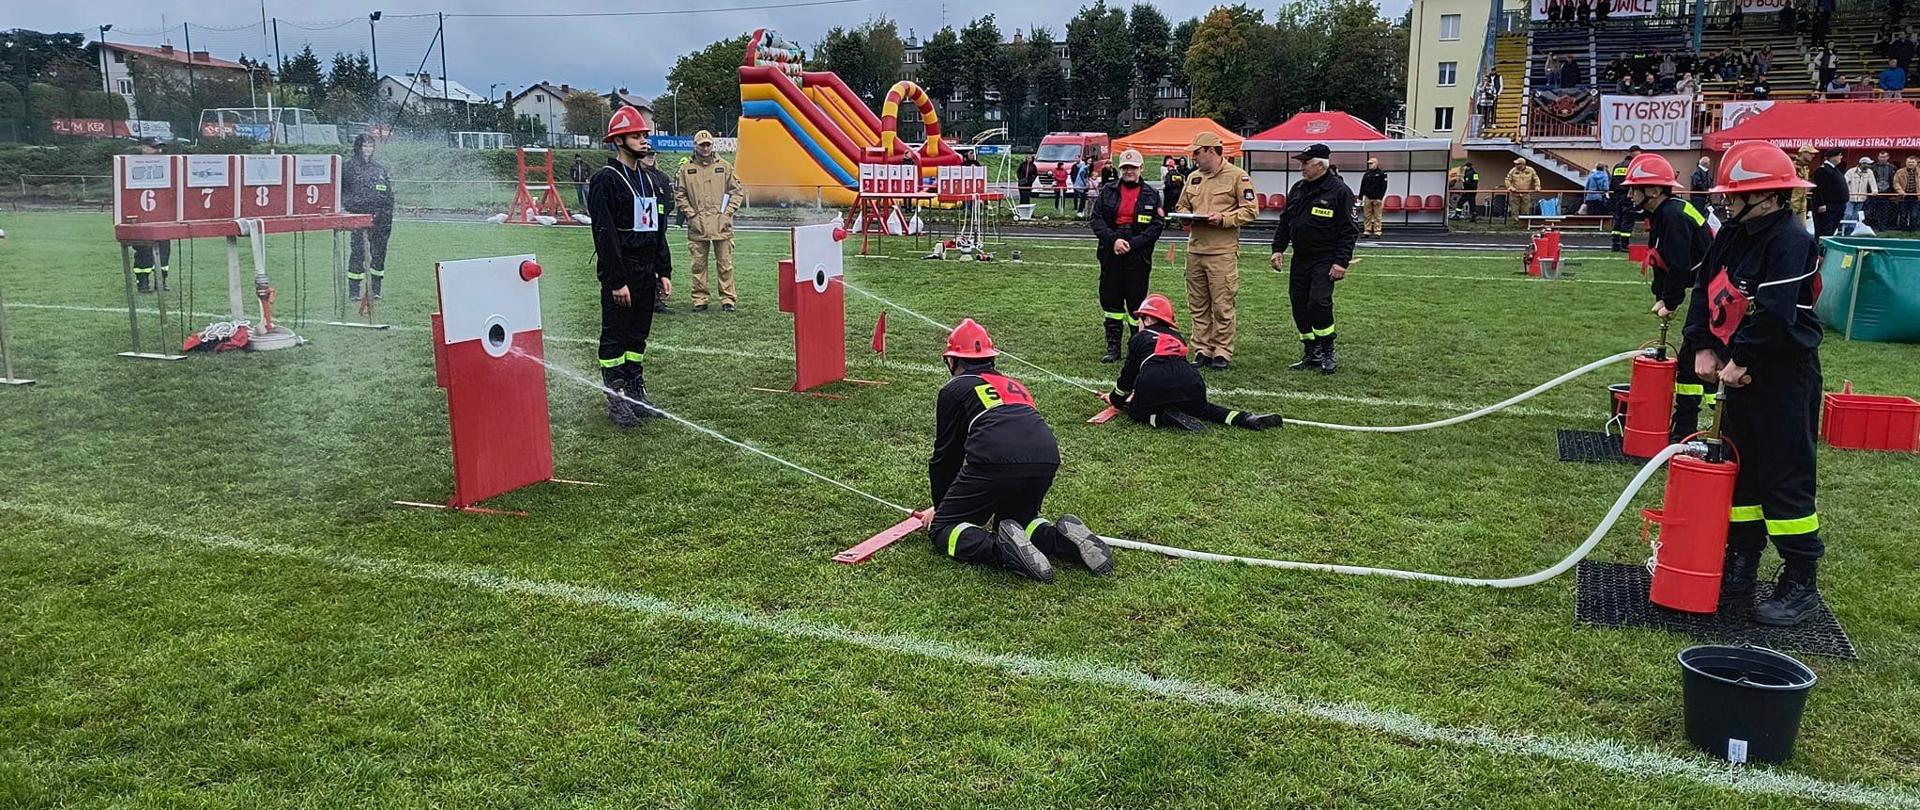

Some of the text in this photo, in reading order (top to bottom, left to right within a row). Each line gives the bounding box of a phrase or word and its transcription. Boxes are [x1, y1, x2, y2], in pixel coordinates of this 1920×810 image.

[1612, 100, 1690, 120] TYGRYSY
[1611, 121, 1689, 146] DO BOJU
[1814, 137, 1865, 148] PAŃSTWOWEJ
[140, 189, 156, 212] 6
[201, 188, 214, 209] 7
[256, 186, 269, 207] 8
[306, 185, 319, 205] 9
